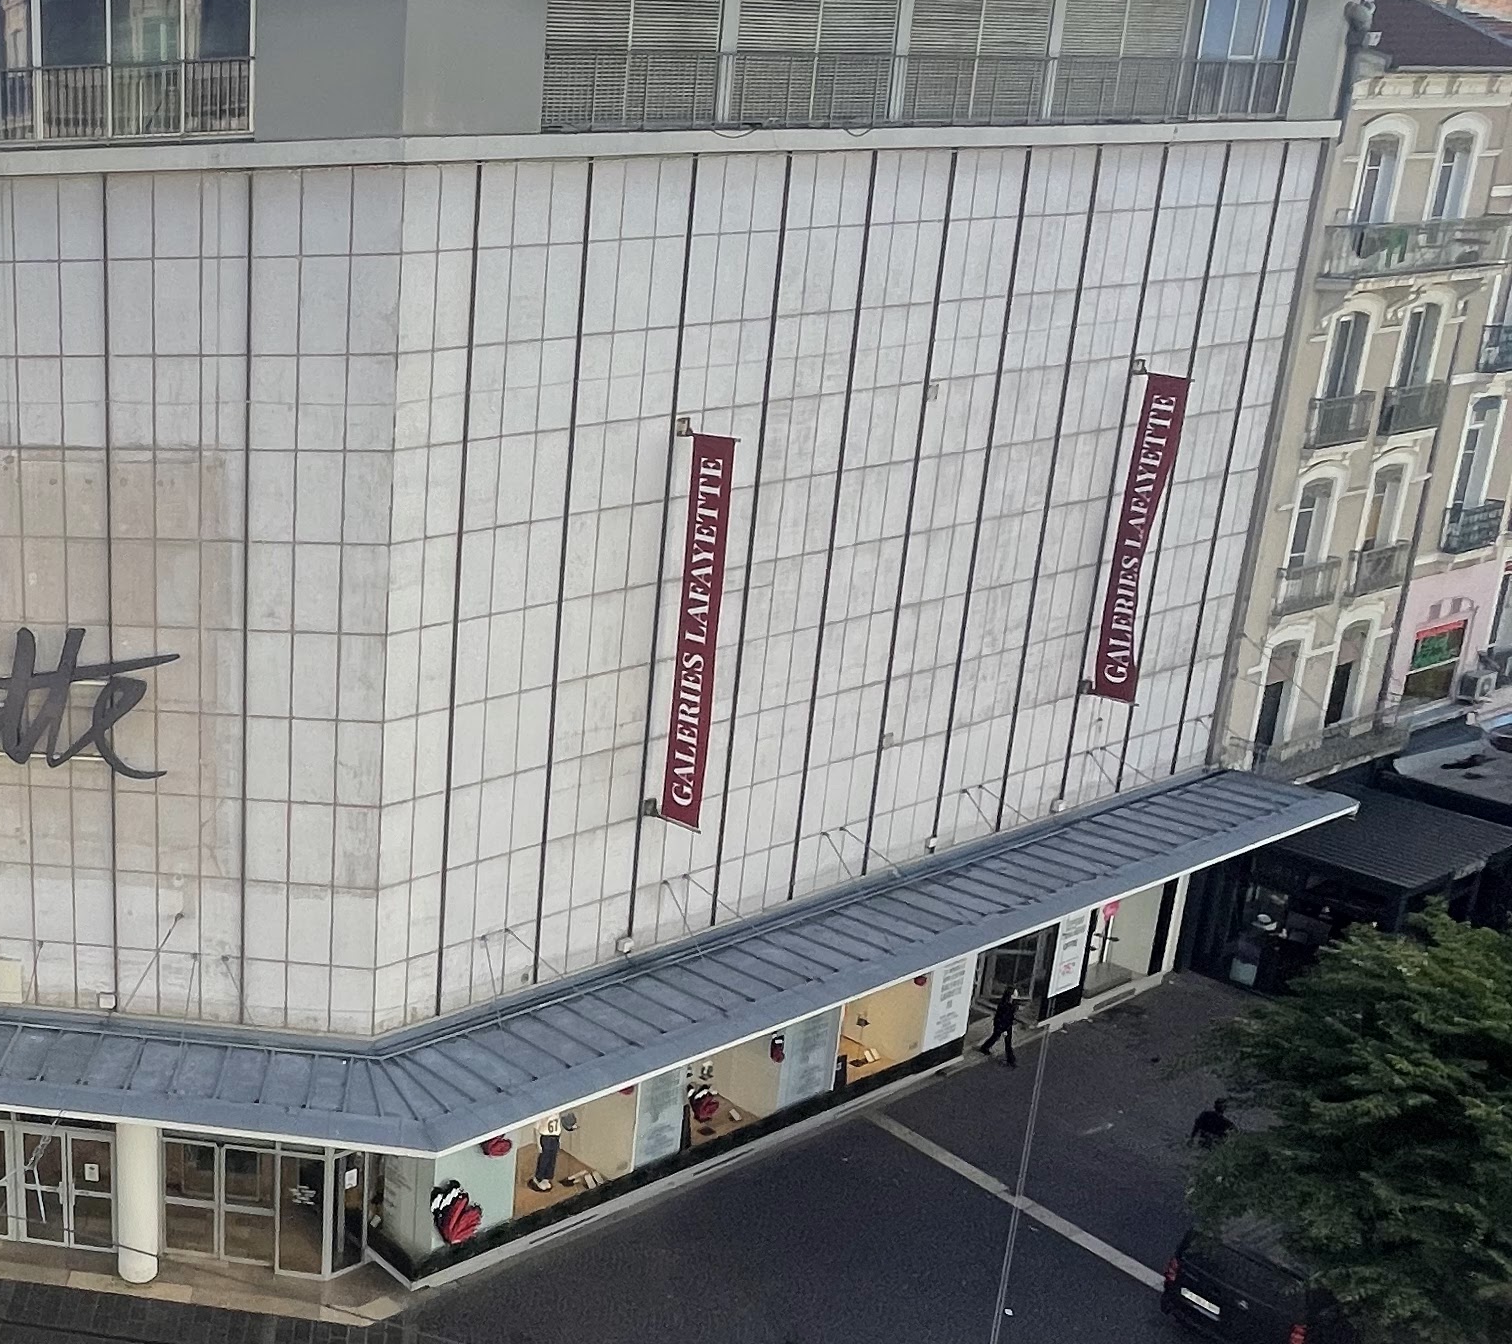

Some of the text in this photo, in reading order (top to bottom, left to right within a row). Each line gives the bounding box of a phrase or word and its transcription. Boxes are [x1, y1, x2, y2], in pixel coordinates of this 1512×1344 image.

[671, 457, 725, 806] GALERIES LAFAYETTE
[1103, 394, 1178, 684] GALERIES LAFAYETTE
